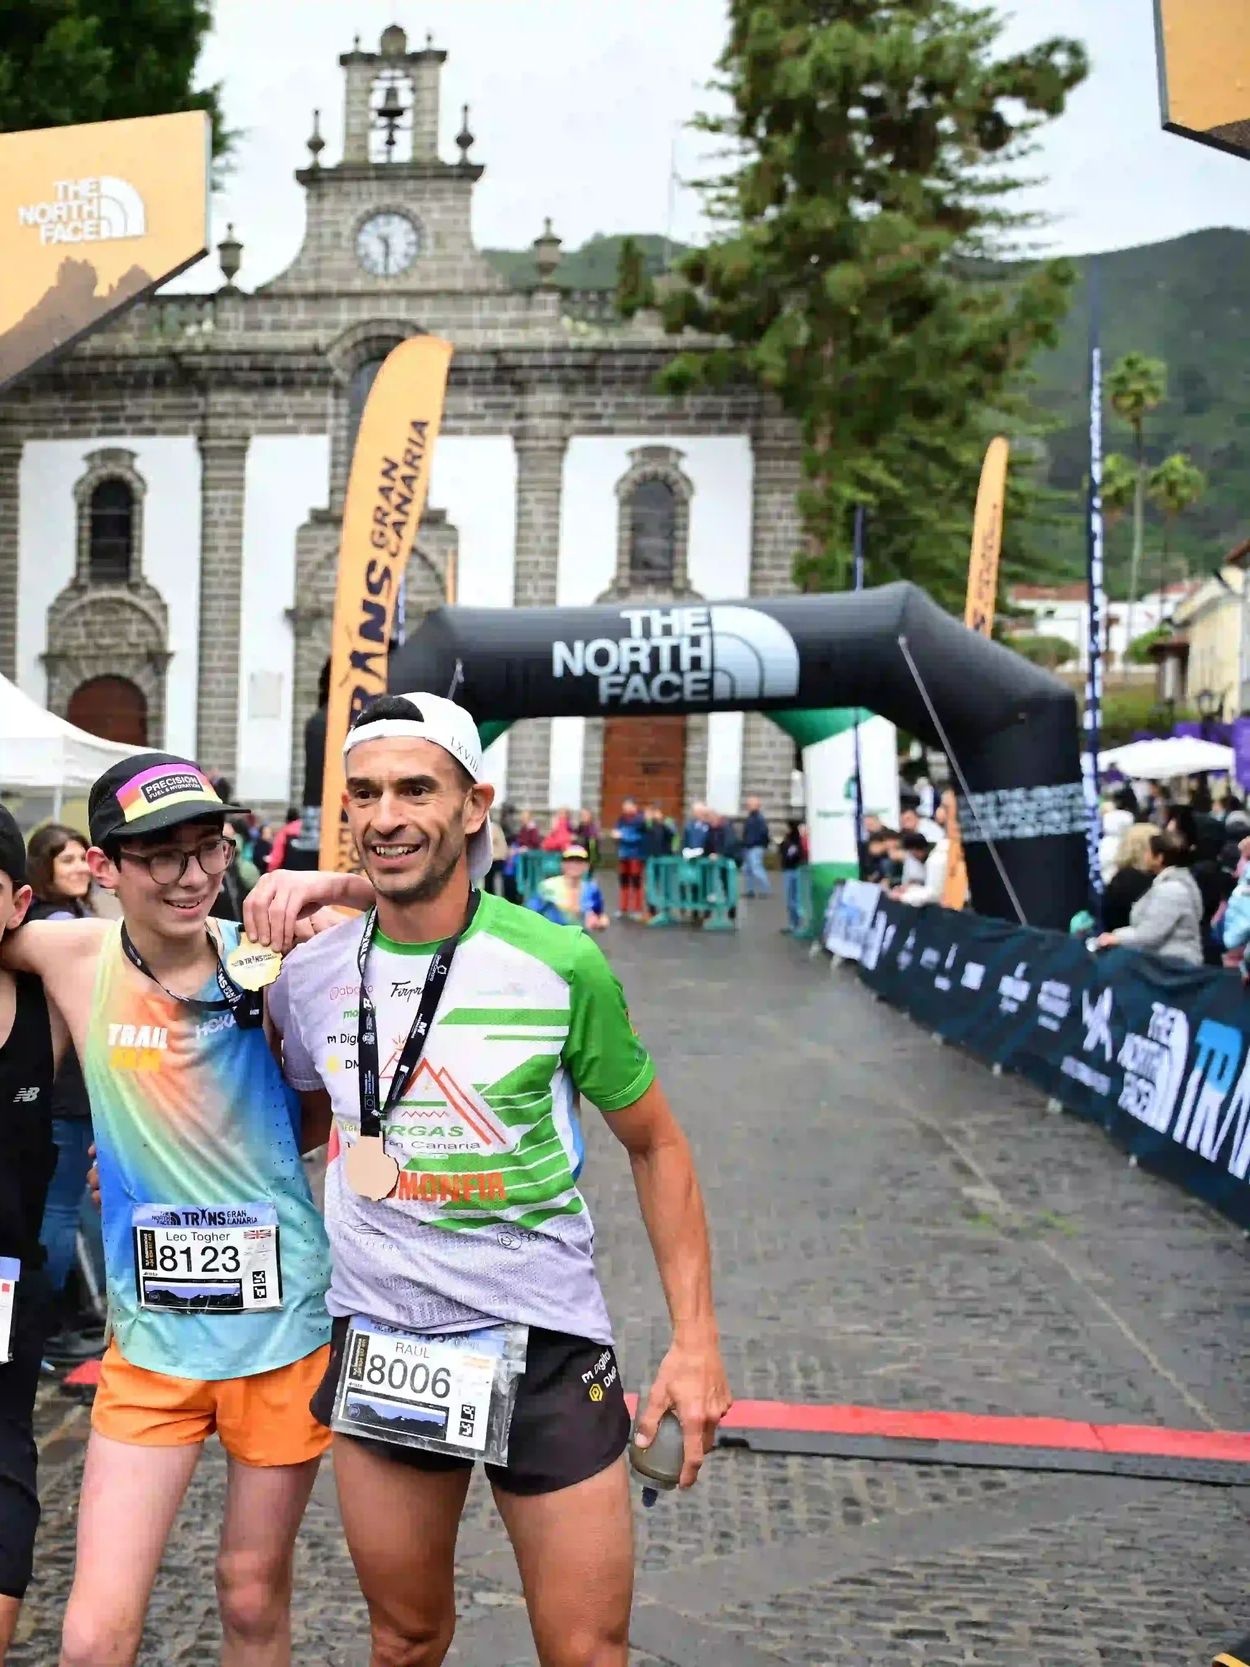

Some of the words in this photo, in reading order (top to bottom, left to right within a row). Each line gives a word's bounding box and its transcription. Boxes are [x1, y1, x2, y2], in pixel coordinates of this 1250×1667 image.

[54, 177, 100, 201] THE
[18, 200, 99, 227] NORTH
[40, 219, 101, 246] FACE
[390, 419, 430, 559] CANARIA
[370, 456, 399, 549] GRAN
[620, 606, 710, 640] THE
[552, 634, 711, 678] NORTH
[599, 671, 711, 704] FACE
[145, 775, 199, 794] PRECISION
[149, 789, 165, 799] FUEL
[108, 1023, 169, 1049] TRAIL
[411, 1140, 481, 1150] Canaria
[182, 1208, 226, 1226] TRANS
[227, 1217, 258, 1225] CANARIA
[166, 1232, 188, 1241] Leo
[191, 1231, 230, 1243] Togher
[159, 1245, 241, 1273] 8123
[395, 1342, 430, 1358] RAUL
[367, 1354, 452, 1398] 8006
